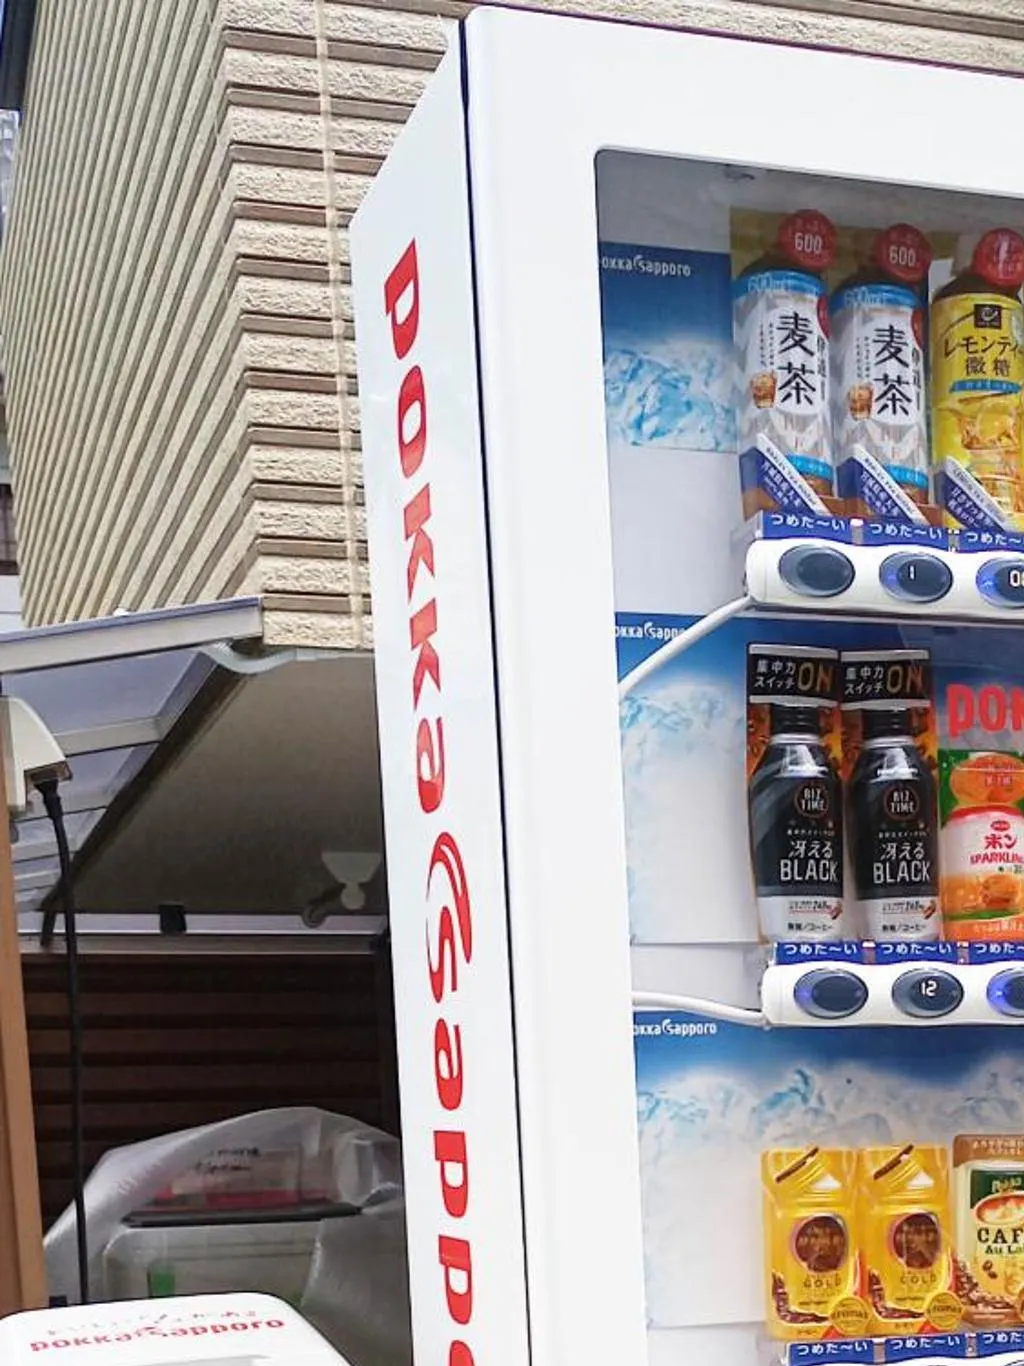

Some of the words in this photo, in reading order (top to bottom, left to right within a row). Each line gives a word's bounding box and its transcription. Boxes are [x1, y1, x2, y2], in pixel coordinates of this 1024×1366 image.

[794, 232, 823, 253] 600
[775, 310, 817, 406] 麦茶
[873, 323, 913, 416] 麦茶
[797, 661, 834, 693] ON
[886, 664, 924, 694] ON
[788, 840, 833, 859] 冴える
[880, 842, 925, 860] 冴える
[779, 859, 839, 882] BLACK
[873, 860, 931, 884] BLACK
